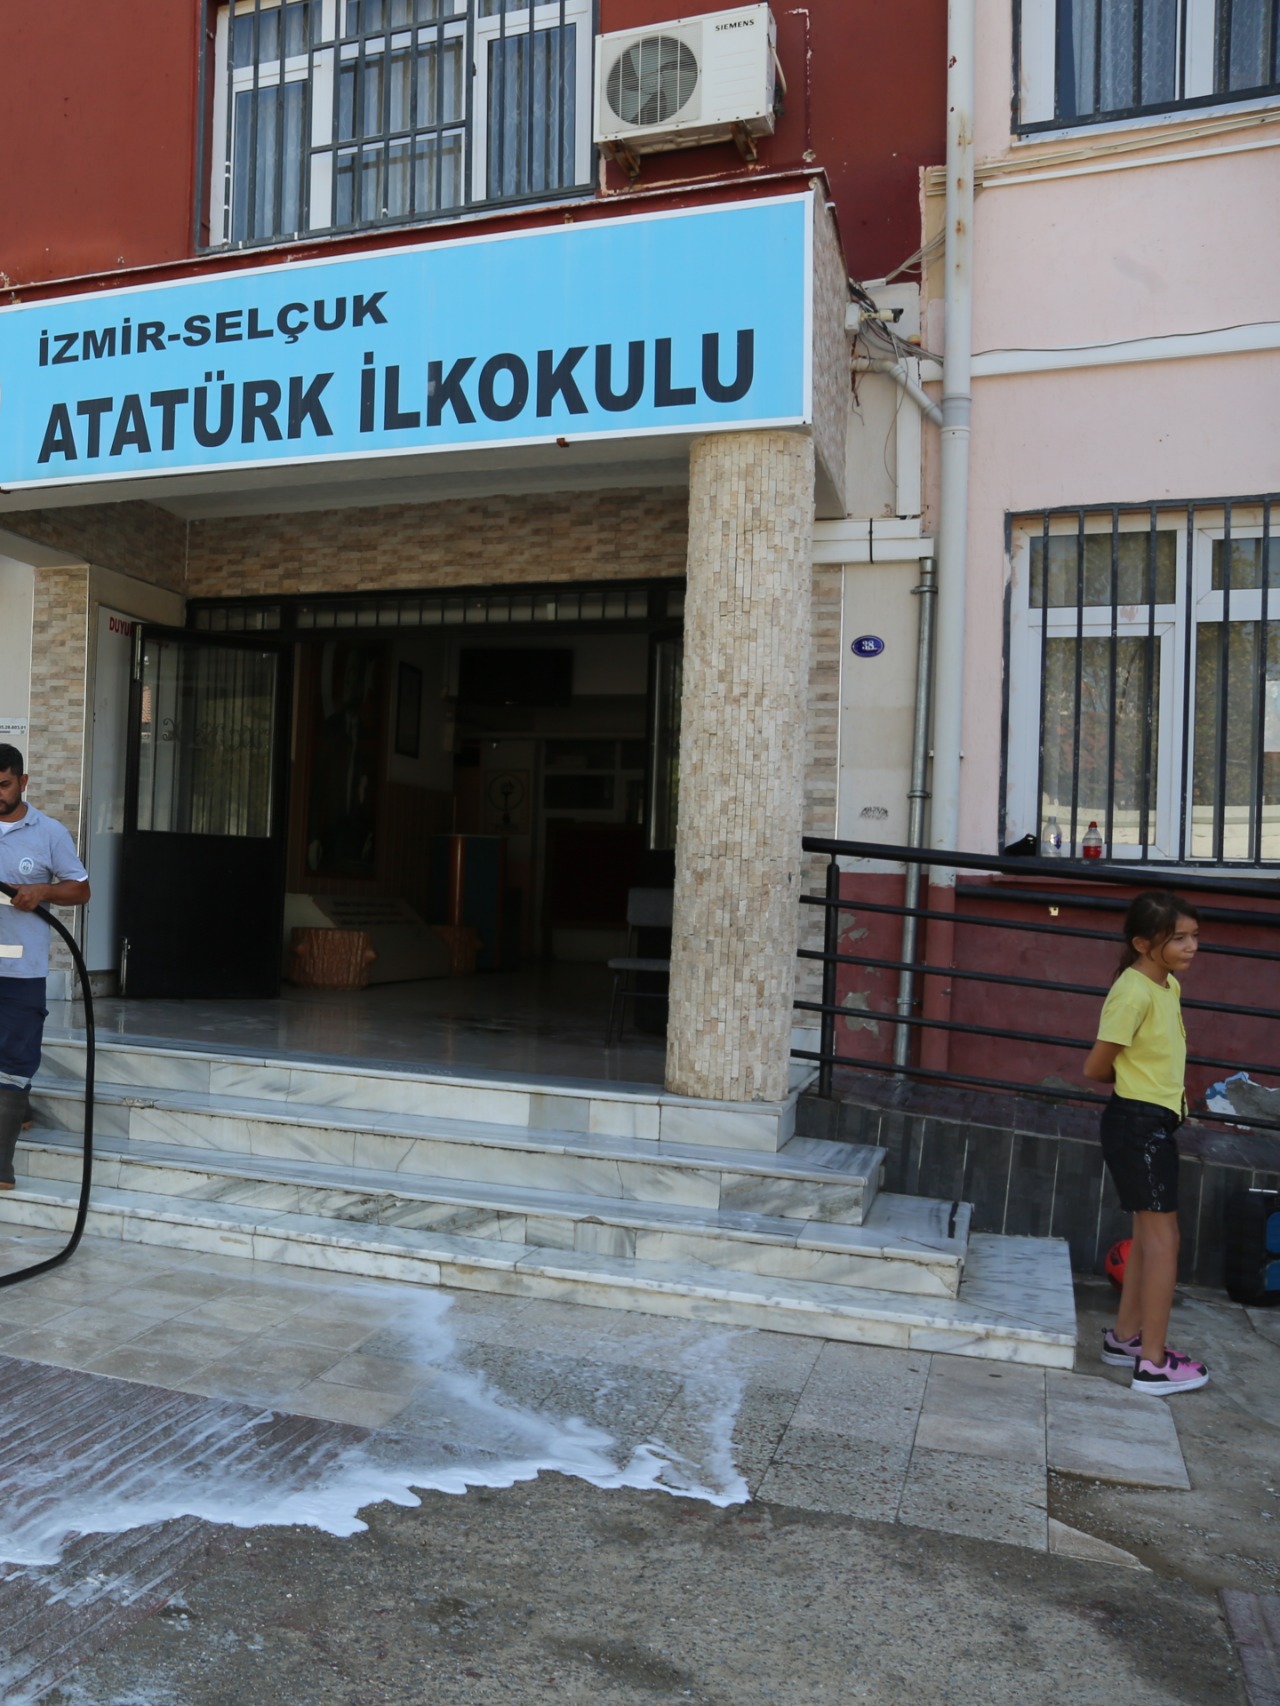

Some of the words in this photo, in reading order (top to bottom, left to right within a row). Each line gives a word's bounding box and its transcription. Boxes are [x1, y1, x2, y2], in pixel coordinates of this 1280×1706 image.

[715, 19, 755, 31] SIEMENS
[38, 291, 389, 367] İZMİR-SELÇUK
[37, 369, 335, 464] ATATÜRK
[359, 328, 755, 433] İLKOKULU
